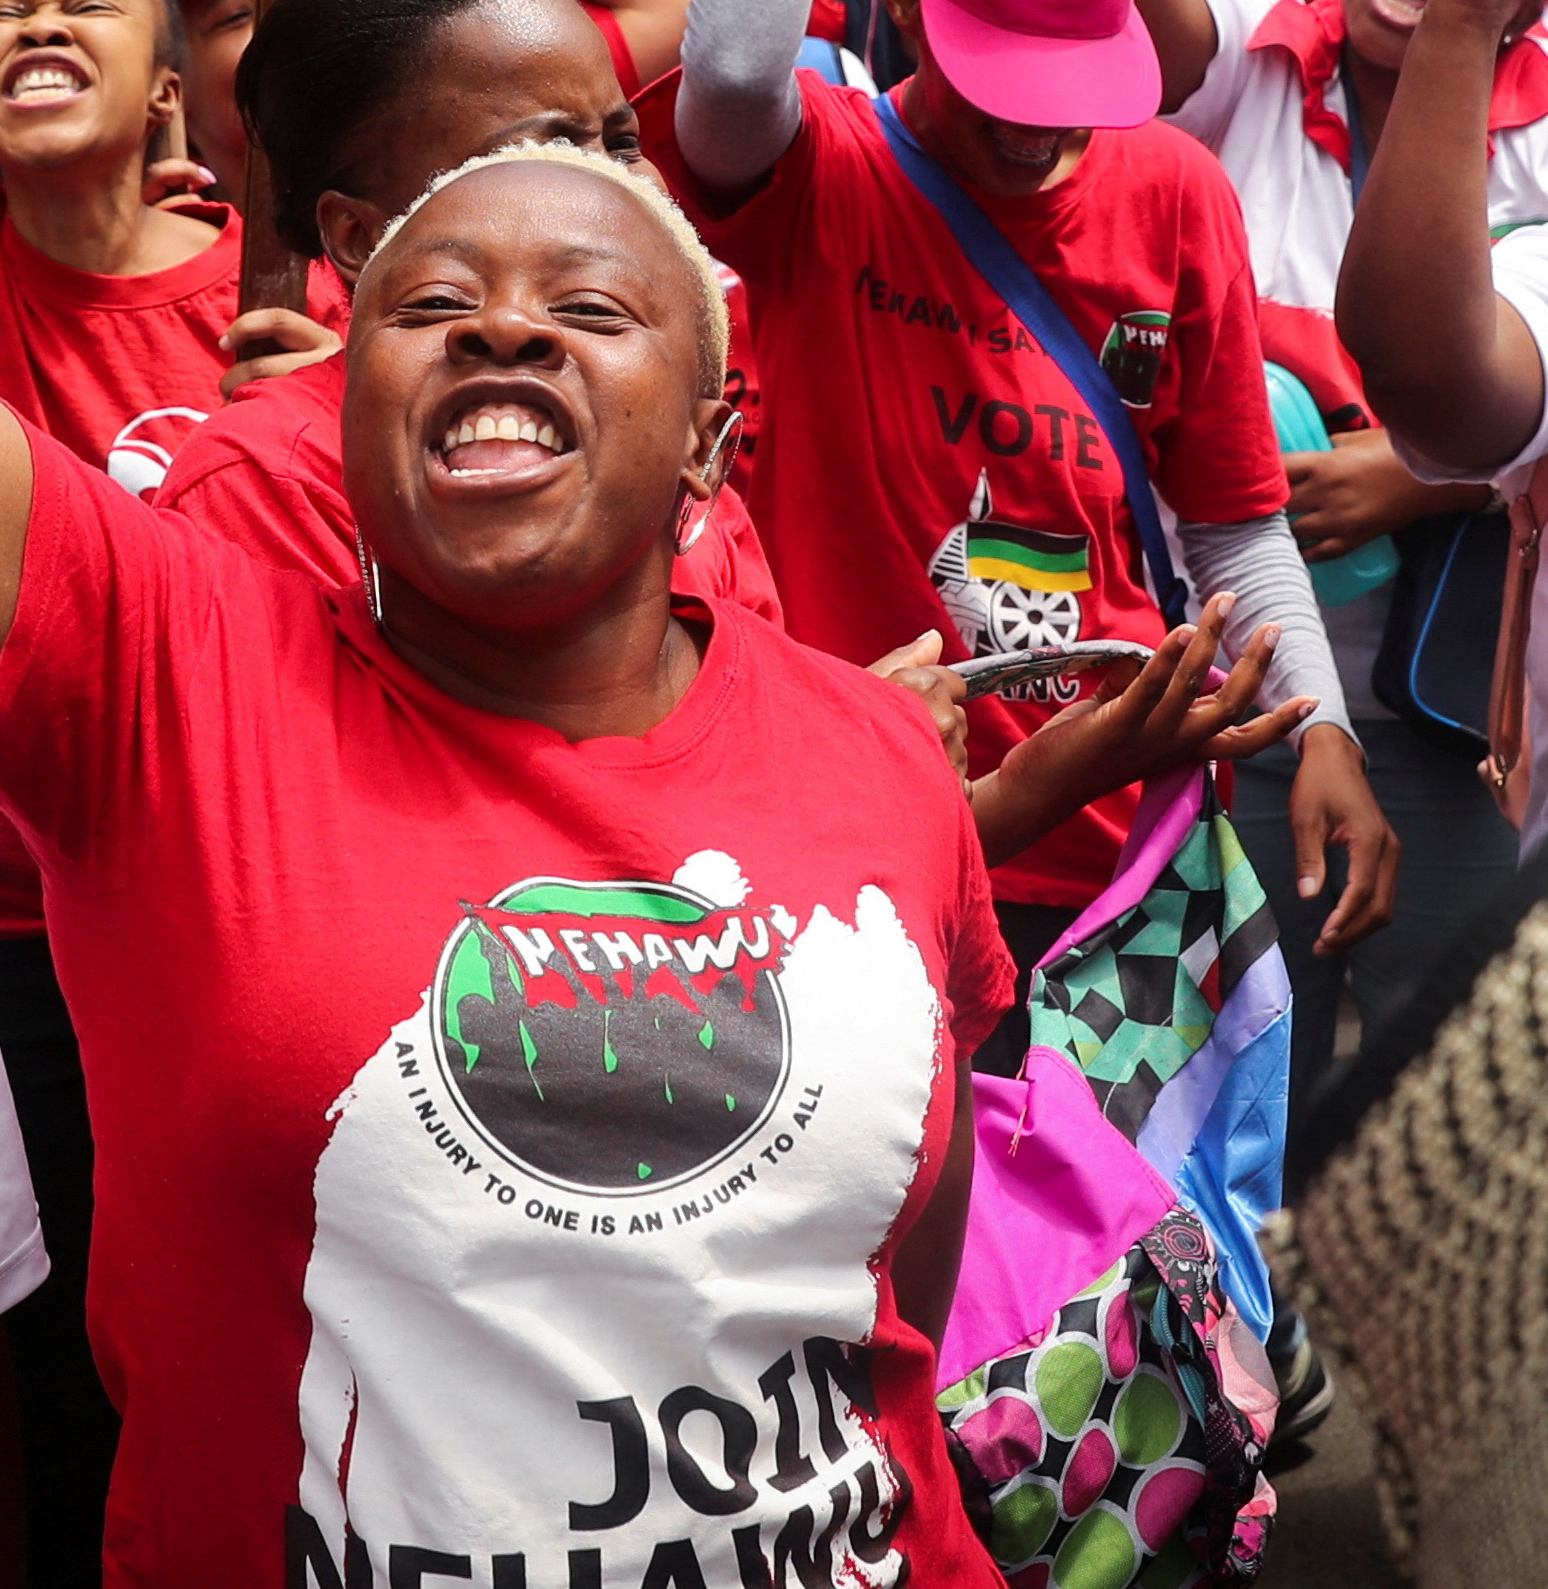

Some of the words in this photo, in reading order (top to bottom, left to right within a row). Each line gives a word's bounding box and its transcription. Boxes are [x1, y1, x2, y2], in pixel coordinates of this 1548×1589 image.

[929, 385, 1104, 471] VOTE
[499, 915, 771, 978] NEHAWU
[394, 1041, 420, 1079] AN
[408, 1087, 482, 1175] INJURY
[484, 1173, 517, 1205] TO
[524, 1199, 580, 1232] ONE
[591, 1214, 616, 1236] IS
[628, 1211, 664, 1235] AN
[672, 1162, 758, 1226] INJURY
[759, 1132, 795, 1165] TO
[792, 1083, 824, 1131] ALL
[568, 1335, 880, 1532] JOIN
